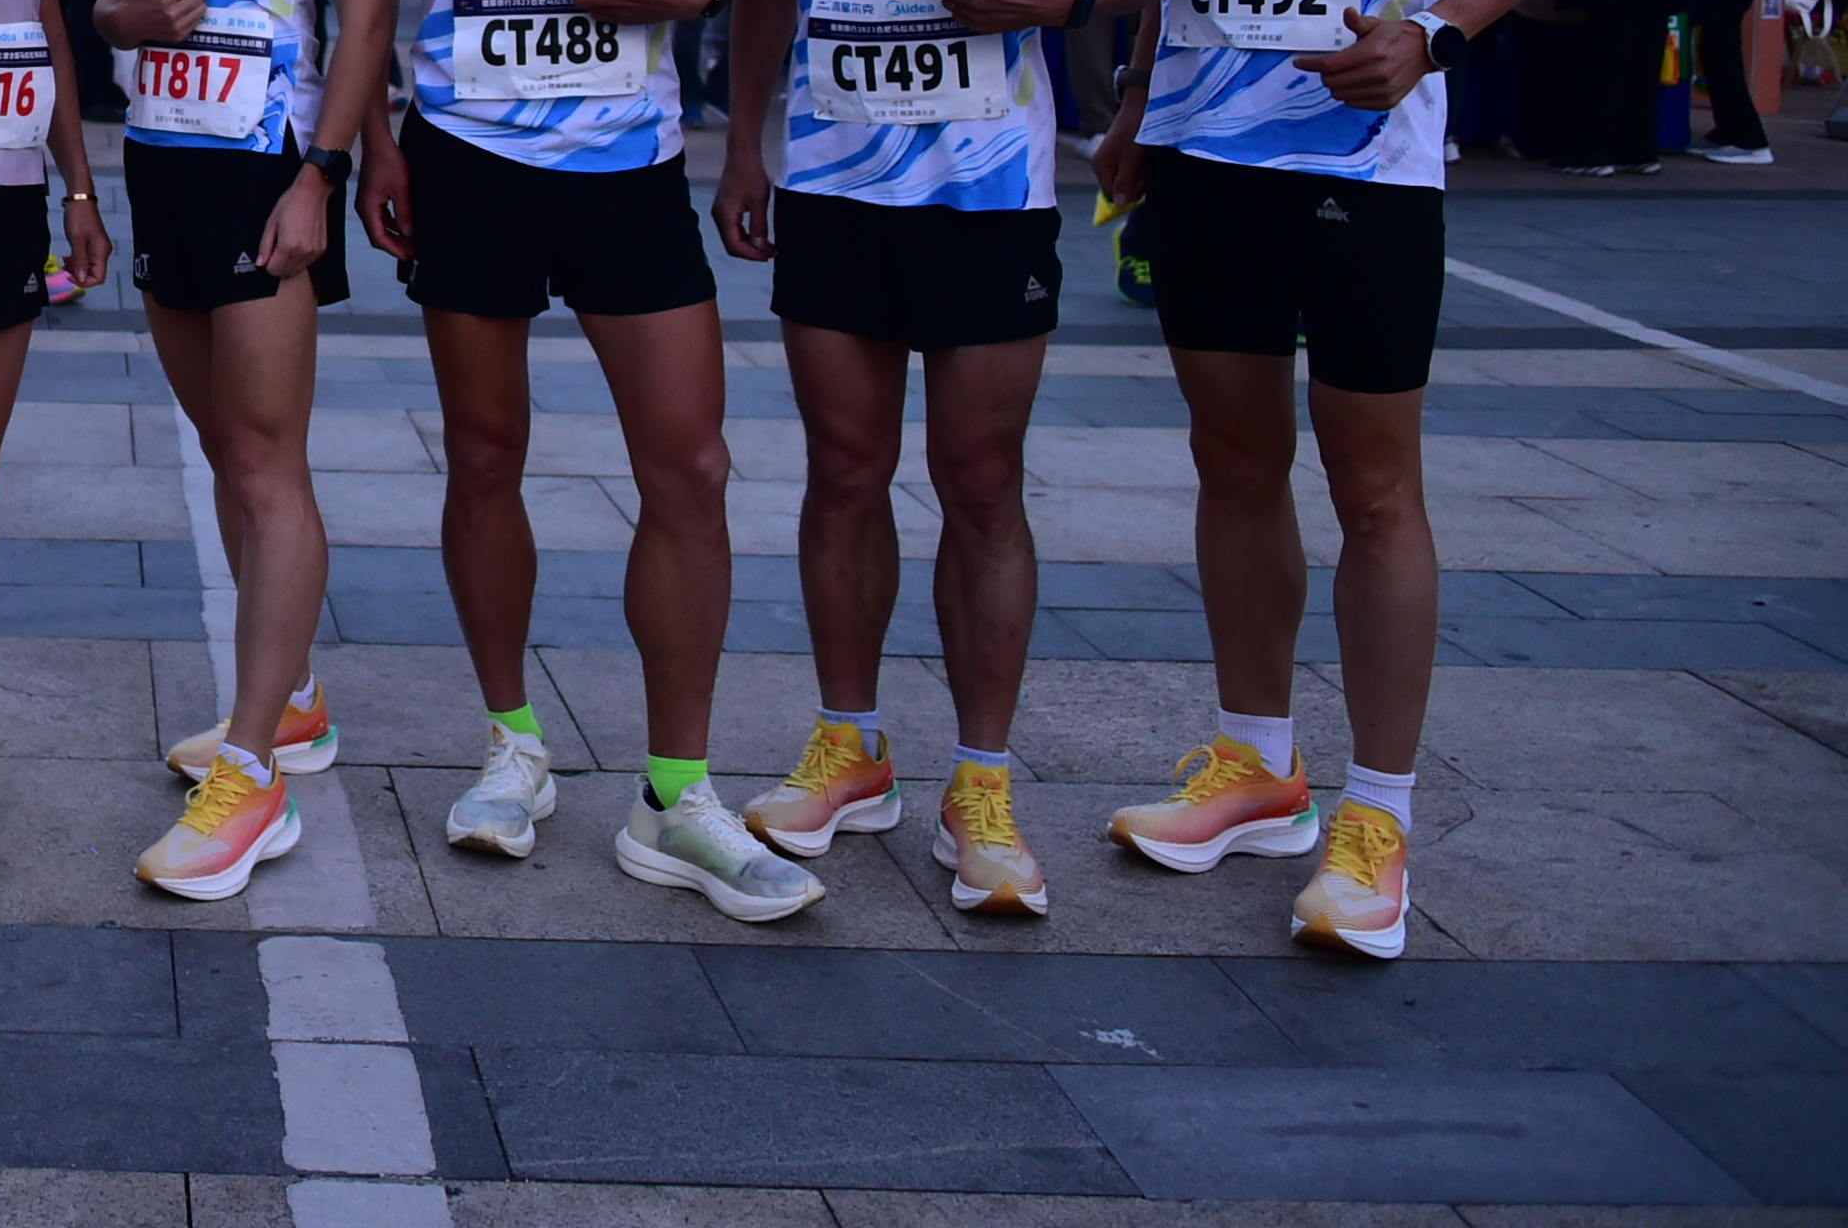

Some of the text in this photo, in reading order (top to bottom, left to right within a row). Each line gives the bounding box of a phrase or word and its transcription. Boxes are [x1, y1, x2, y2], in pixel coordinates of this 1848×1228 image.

[482, 16, 618, 66] CT488
[833, 41, 970, 92] CT491
[138, 50, 241, 102] CT817
